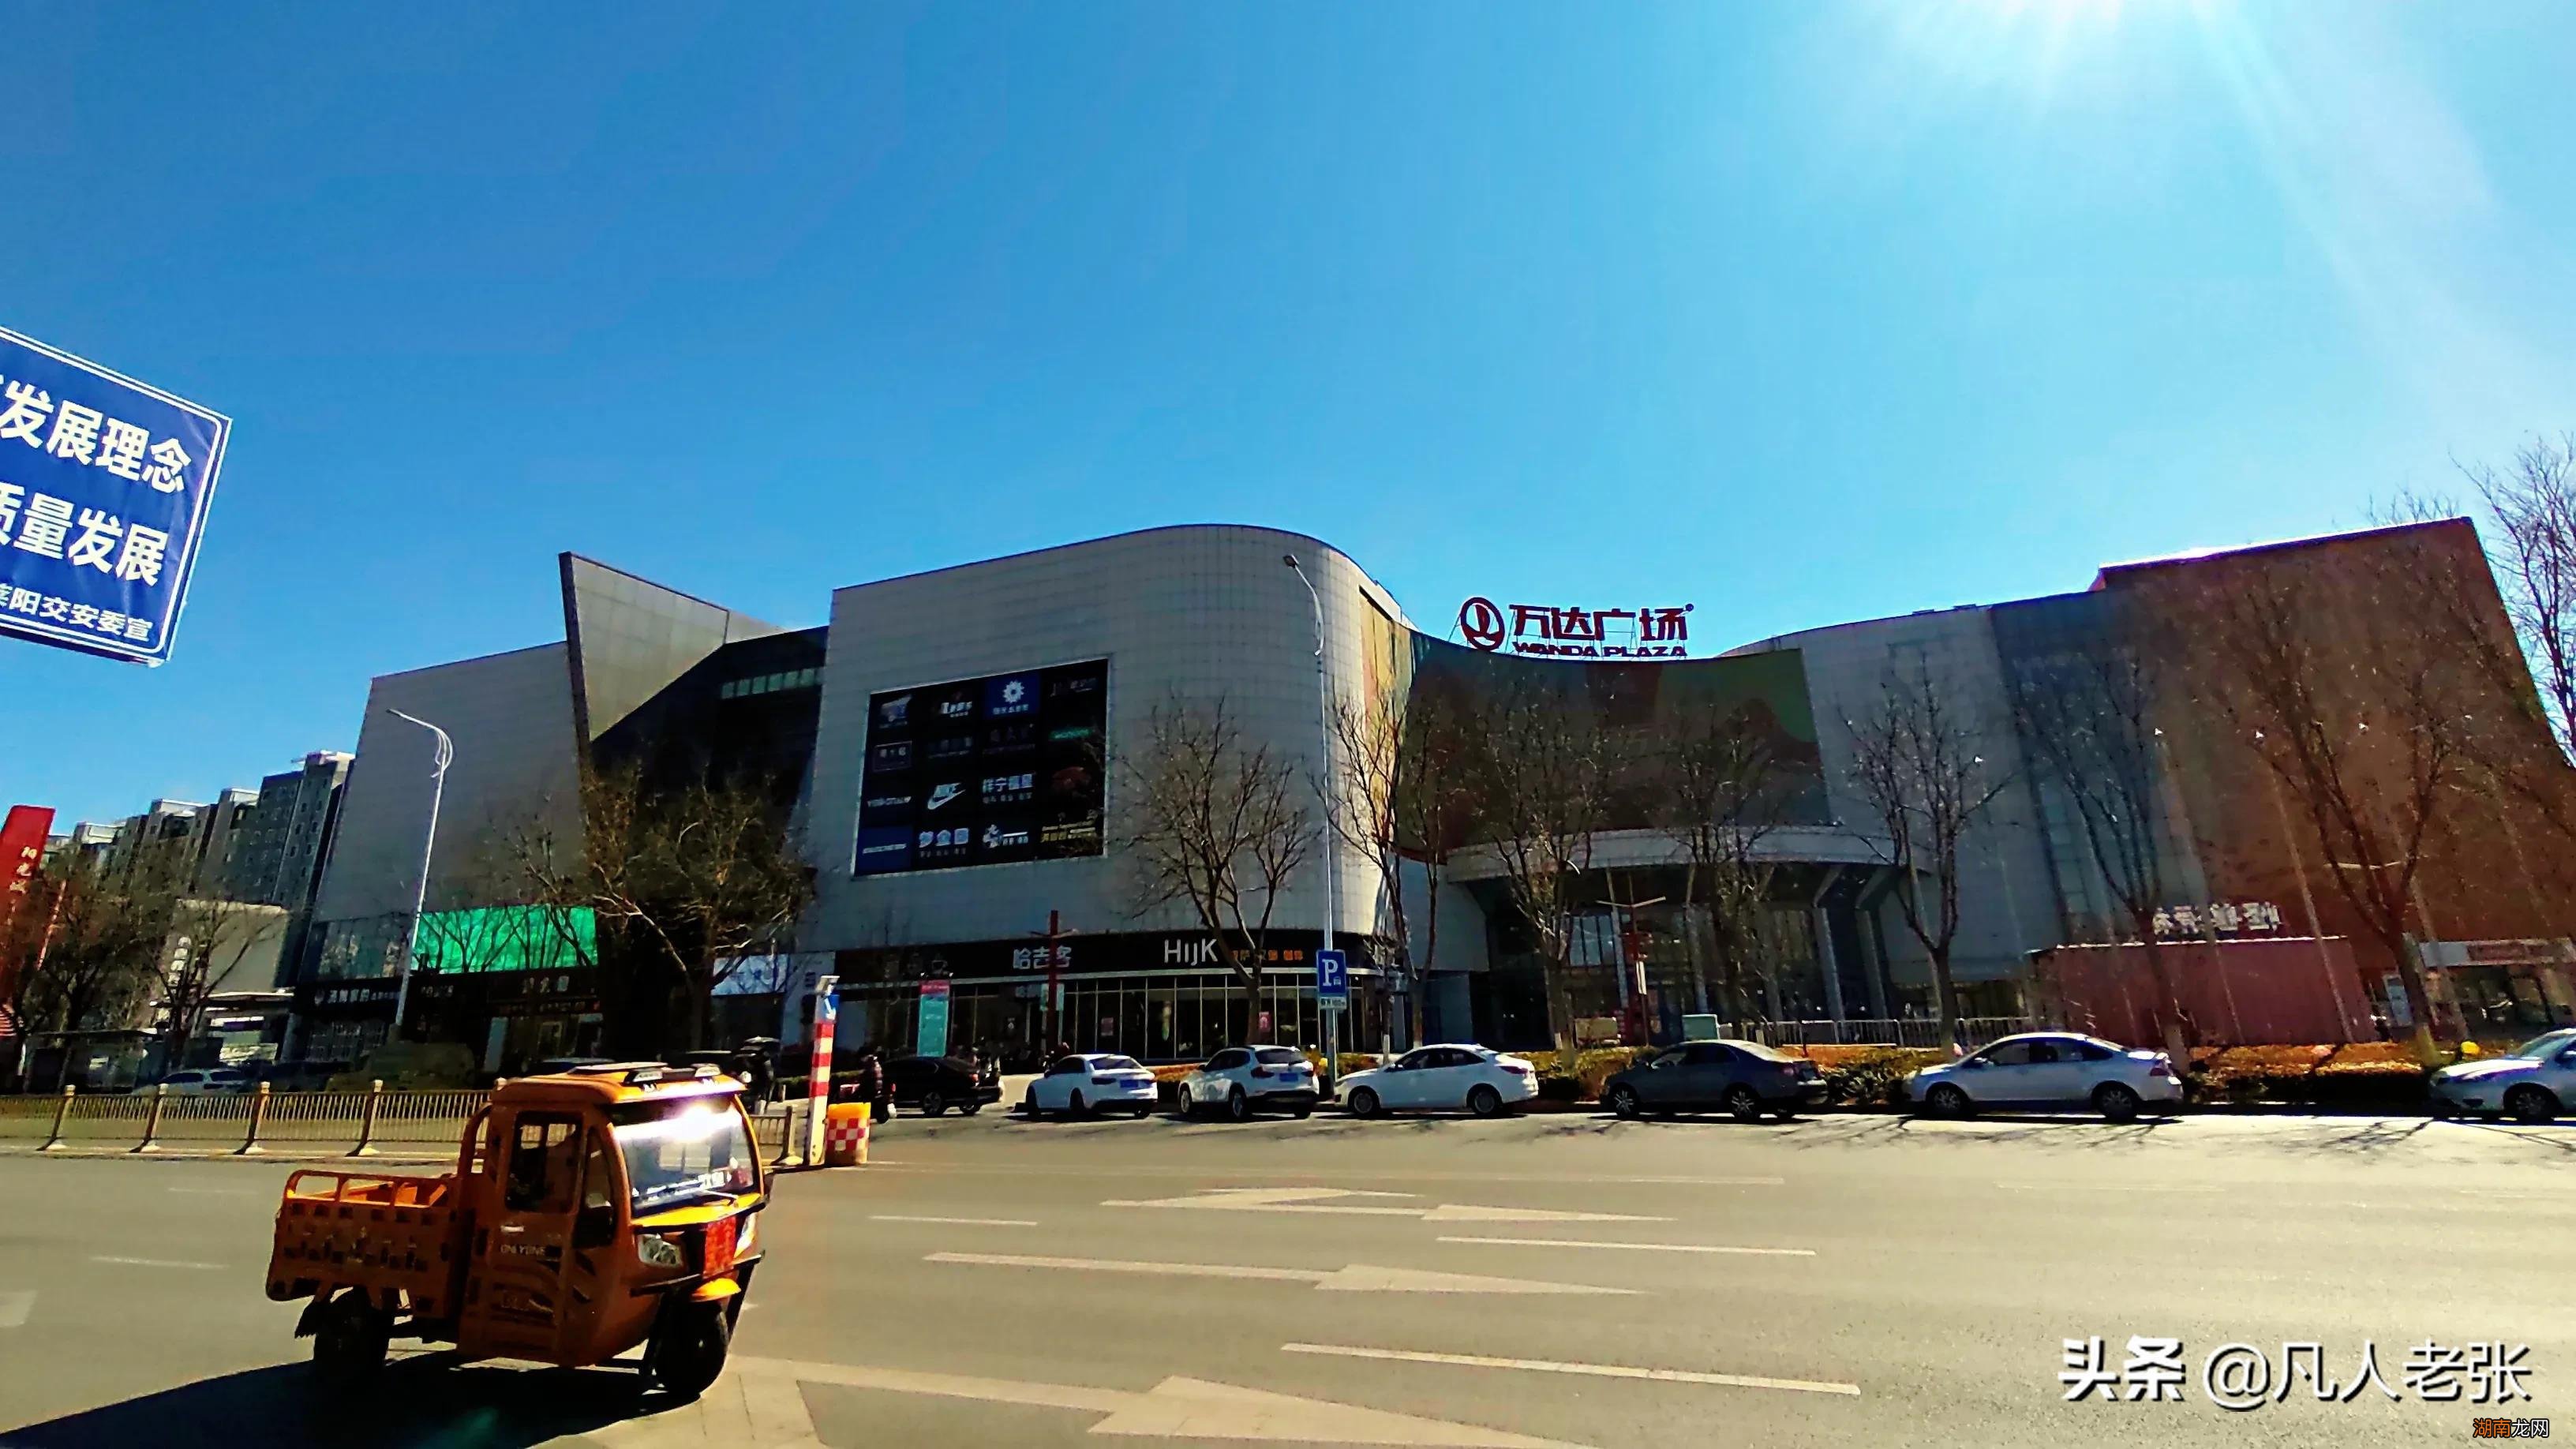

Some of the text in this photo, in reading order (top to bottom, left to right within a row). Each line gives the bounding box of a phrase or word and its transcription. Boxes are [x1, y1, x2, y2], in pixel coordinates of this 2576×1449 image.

[0, 379, 192, 494] 发展理念
[1509, 604, 1687, 641] 万达广场
[1512, 641, 1687, 657] WANDA PLAZA
[1321, 958, 1339, 987] P
